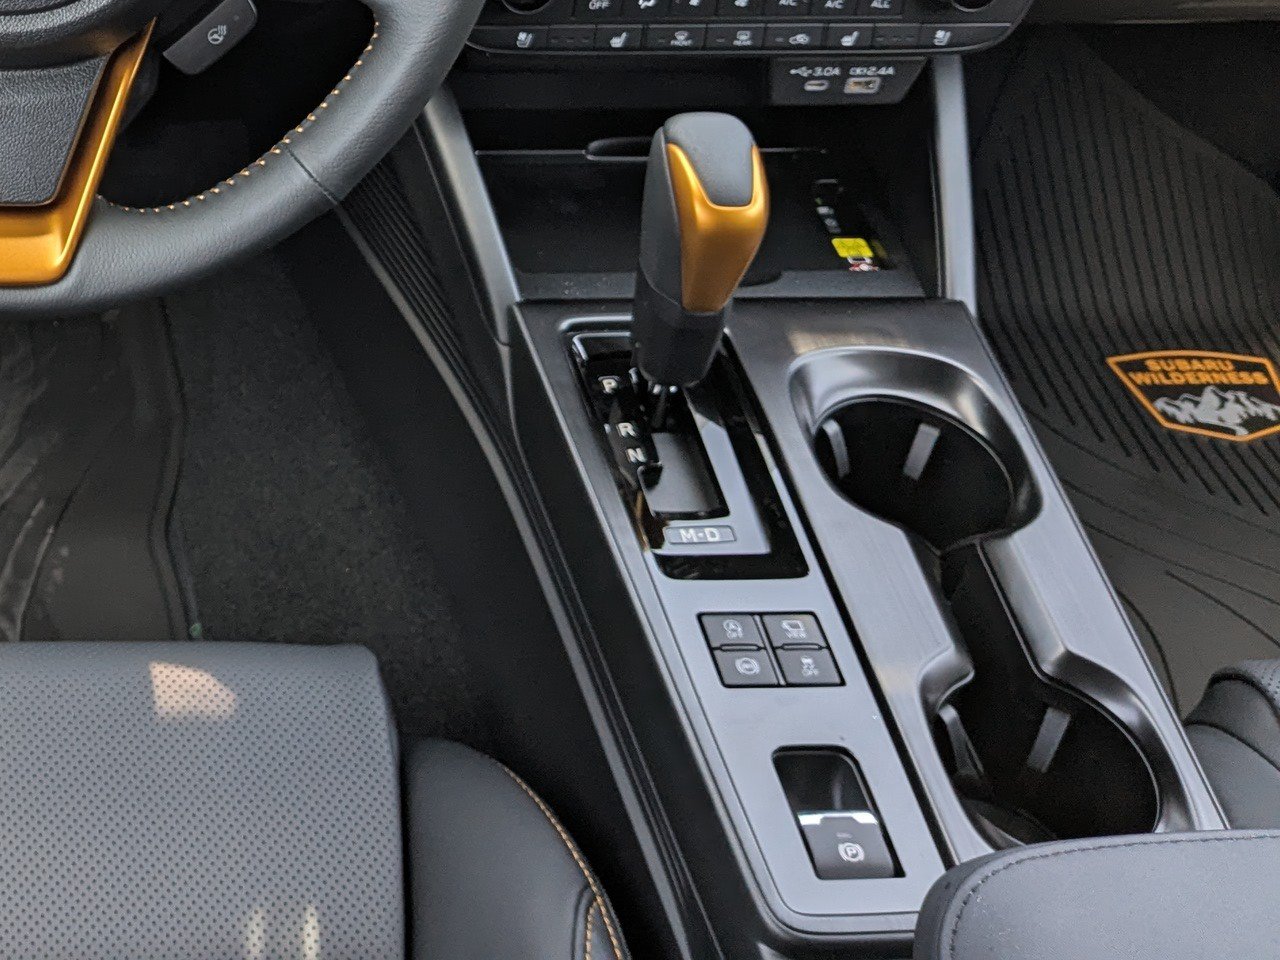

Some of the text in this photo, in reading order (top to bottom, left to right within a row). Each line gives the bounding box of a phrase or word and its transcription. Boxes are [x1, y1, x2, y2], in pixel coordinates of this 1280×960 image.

[588, 0, 610, 10] OFF
[824, 0, 844, 9] A/C
[1144, 358, 1235, 371] SUBARU
[601, 377, 619, 394] P
[1128, 371, 1270, 386] WILDERNESS
[616, 422, 637, 439] R
[627, 447, 647, 464] N
